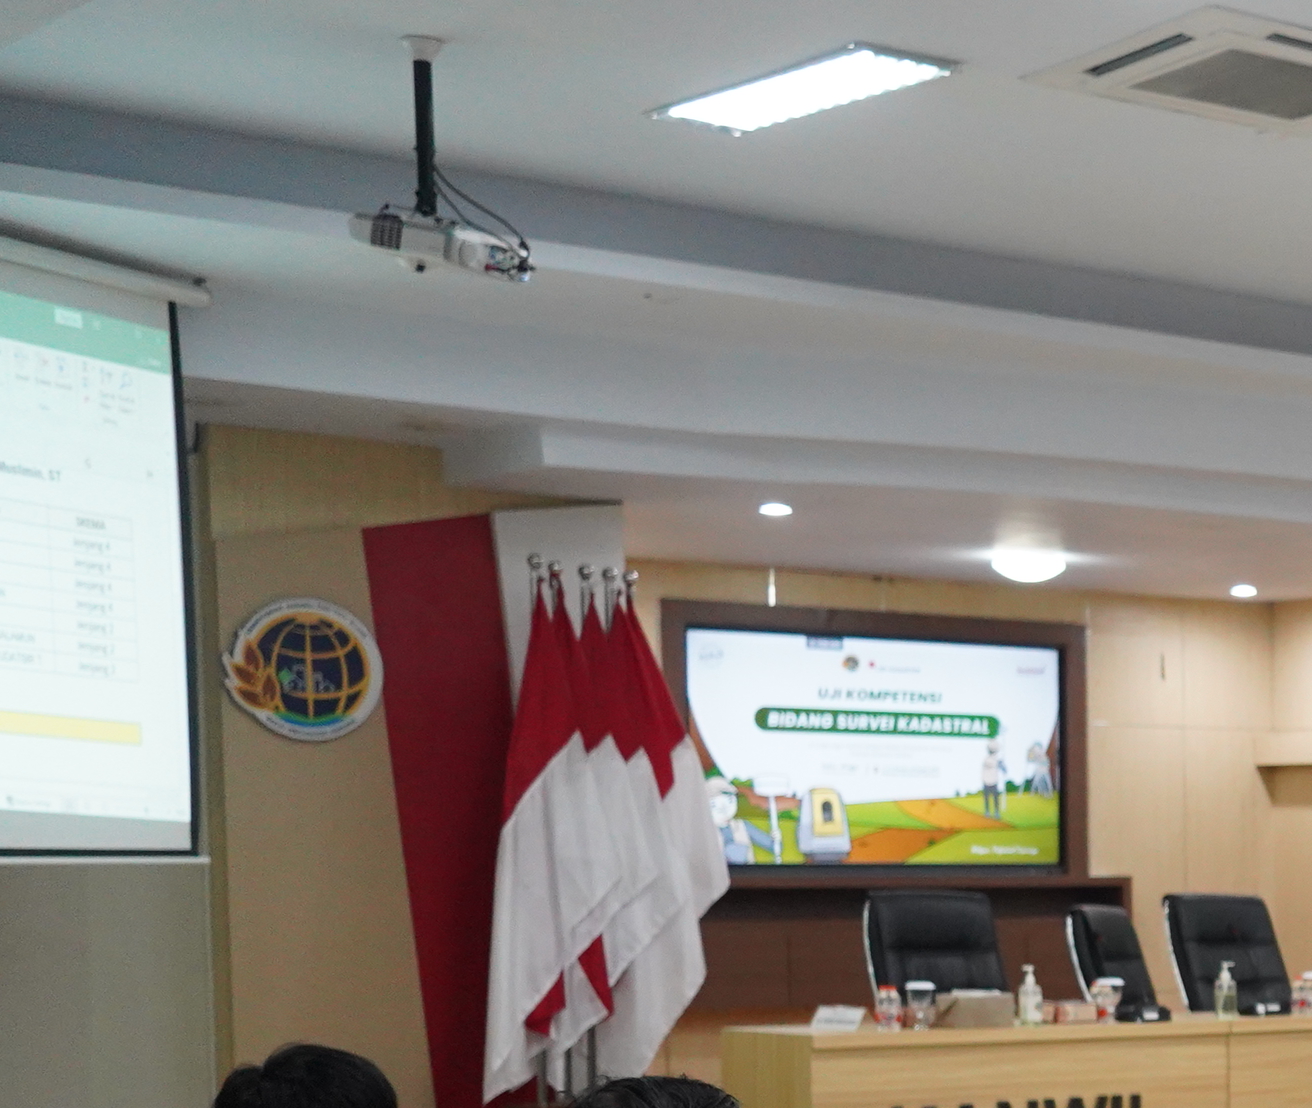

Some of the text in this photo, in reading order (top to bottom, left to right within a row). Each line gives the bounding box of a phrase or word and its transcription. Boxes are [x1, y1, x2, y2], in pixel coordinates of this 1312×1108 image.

[818, 687, 942, 704] UJI KOMPETENSI
[767, 712, 990, 736] BIDANG SURVEI KADASTRAL
